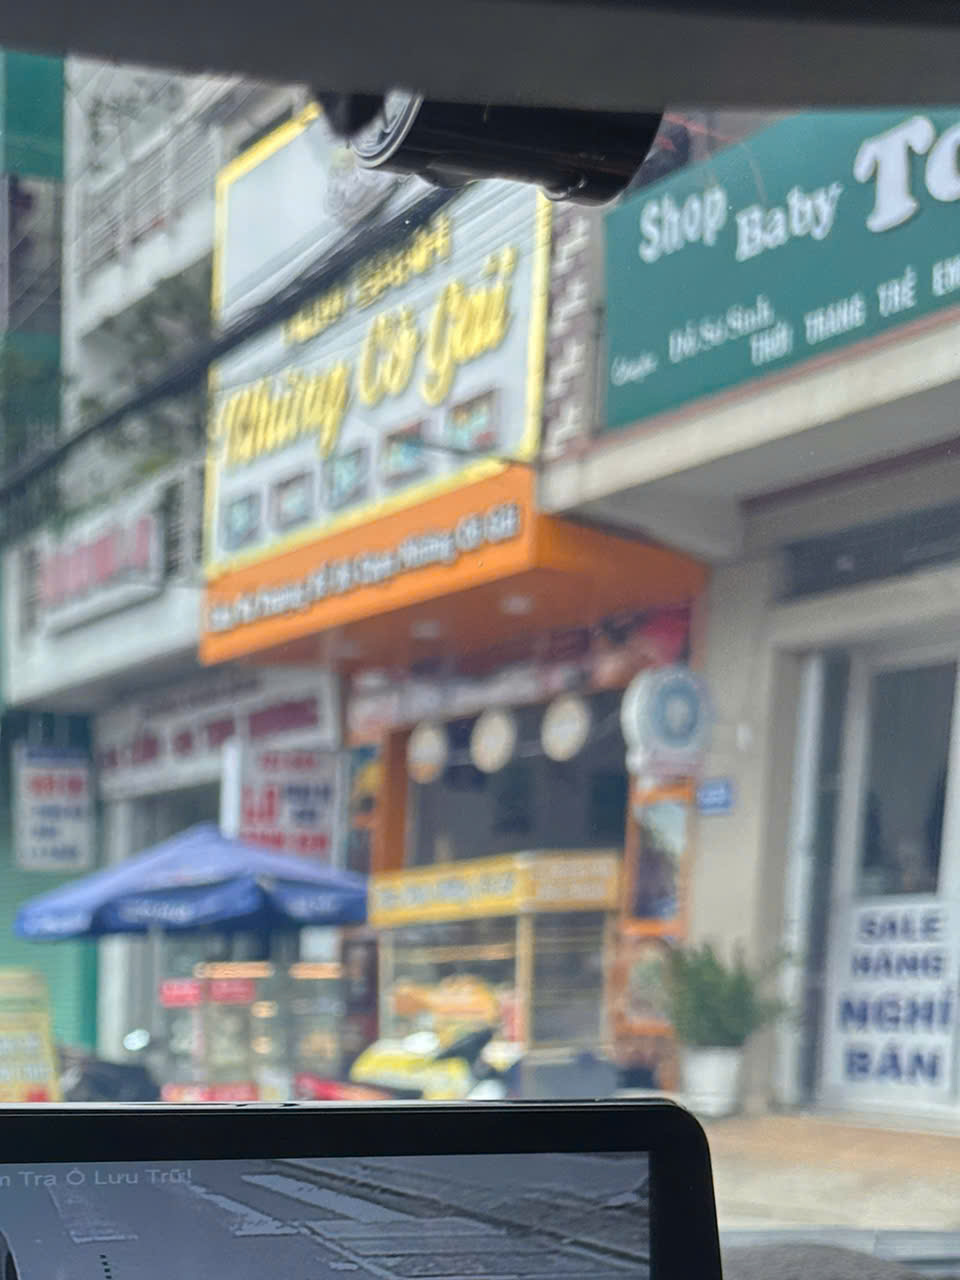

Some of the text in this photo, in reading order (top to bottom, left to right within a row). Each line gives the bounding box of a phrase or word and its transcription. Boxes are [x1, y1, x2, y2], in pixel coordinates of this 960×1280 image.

[640, 186, 728, 263] Shop
[736, 183, 844, 262] Baby
[859, 913, 942, 942] SALE
[18, 1170, 58, 1187] Tra
[94, 1169, 139, 1186] Lưu
